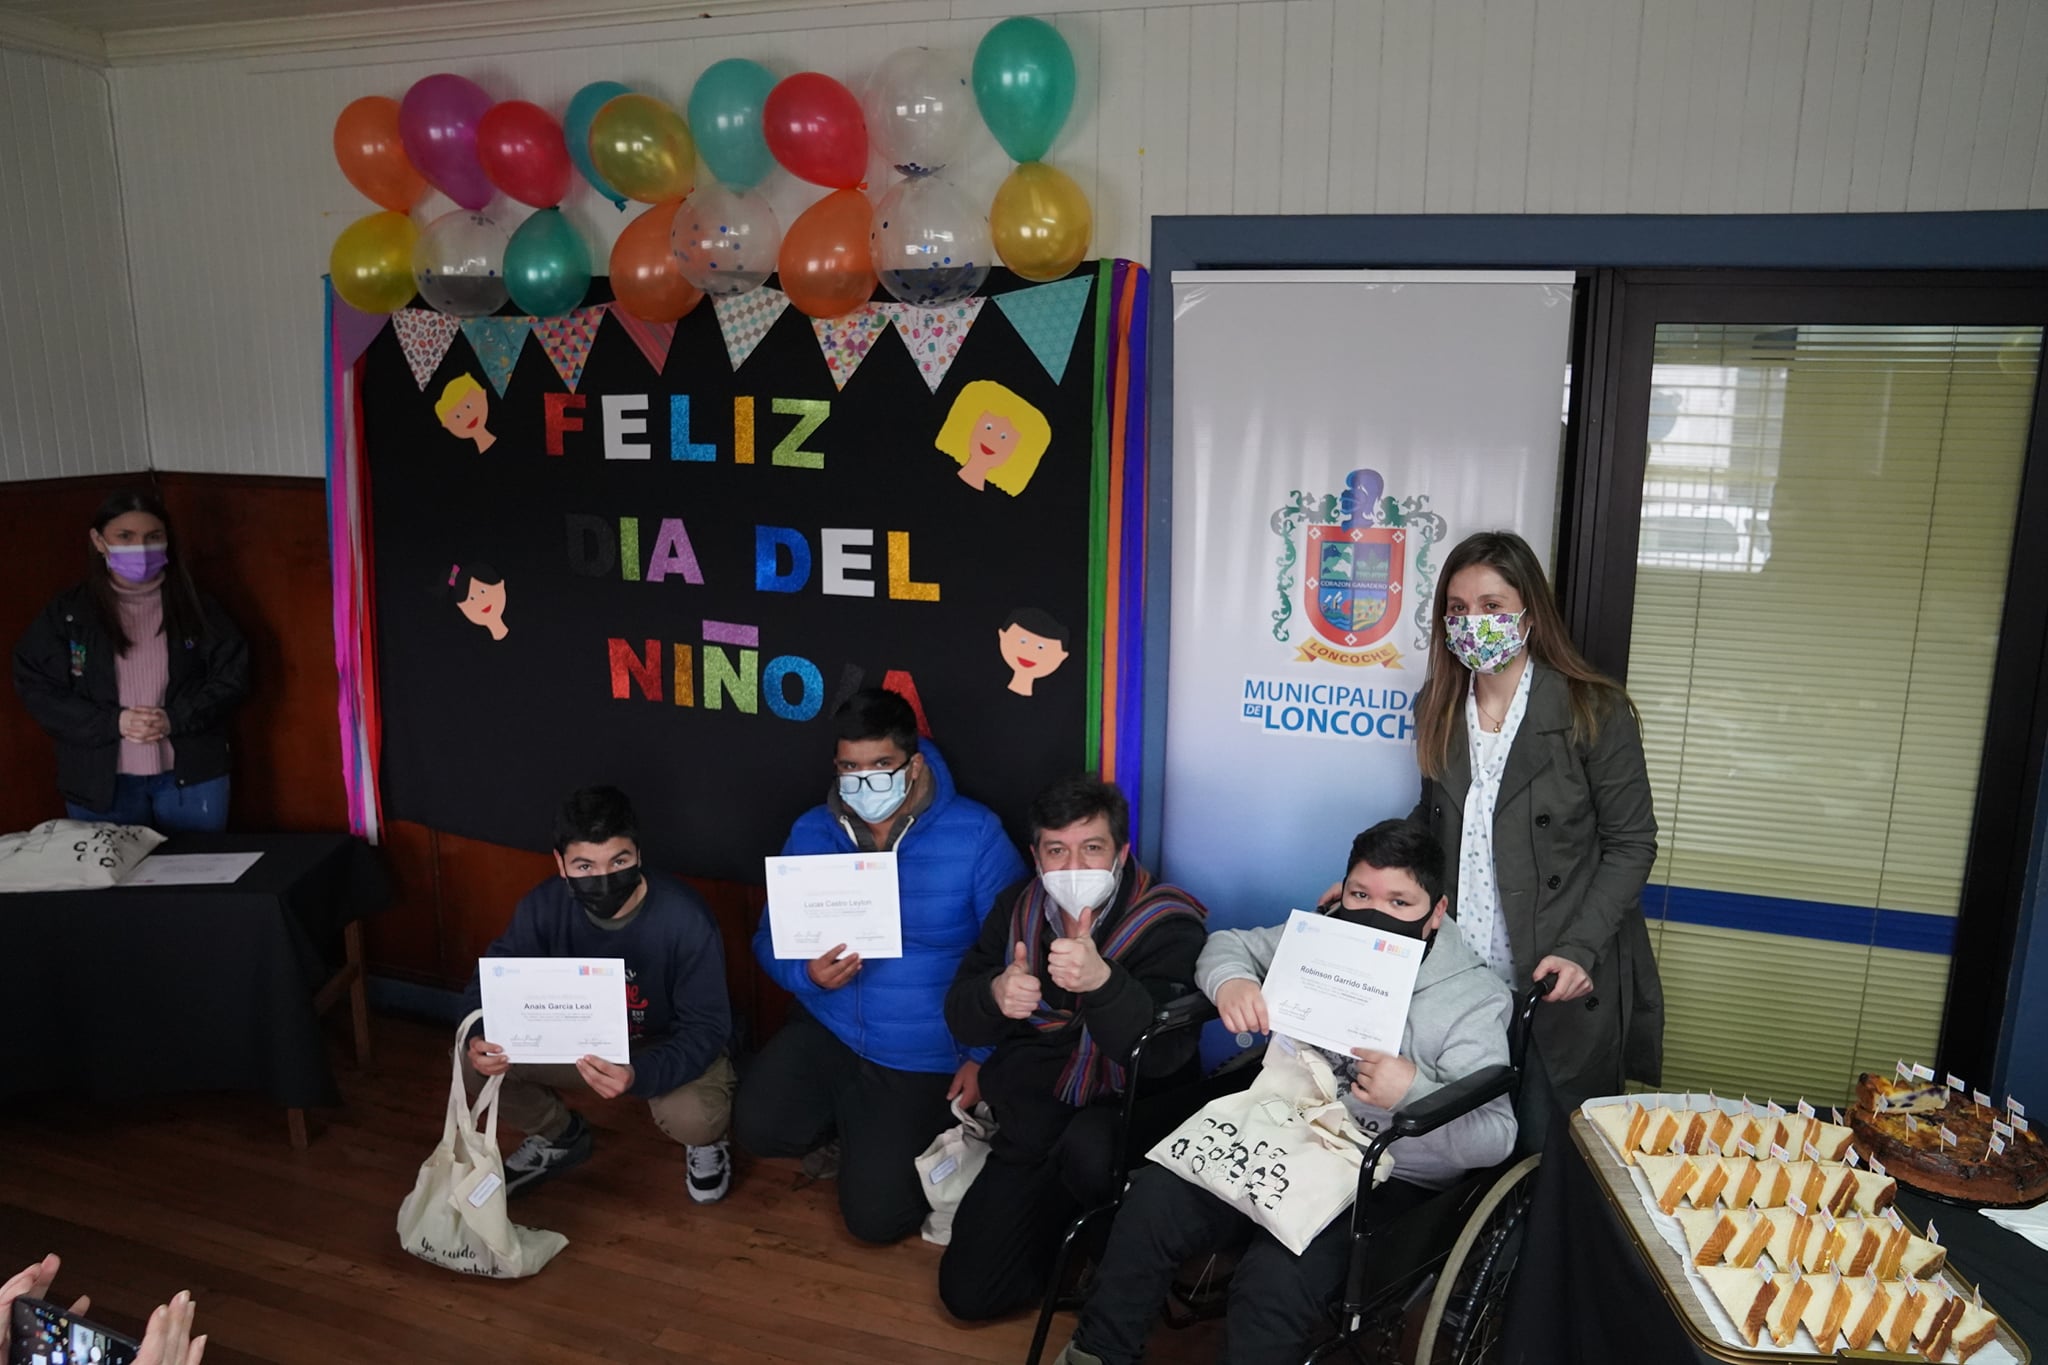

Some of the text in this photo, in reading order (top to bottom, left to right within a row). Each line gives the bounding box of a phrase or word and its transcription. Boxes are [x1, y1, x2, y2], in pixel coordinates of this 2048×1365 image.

[543, 393, 831, 469] FELIZ
[564, 512, 941, 602] DIA DEL
[1308, 641, 1390, 664] LONCOCHE
[1246, 704, 1417, 741] DE LONCOCH
[1300, 965, 1333, 981] Robinson
[1333, 974, 1361, 989] Garrido
[1361, 983, 1389, 998] Salinas
[575, 1002, 592, 1010] Leal
